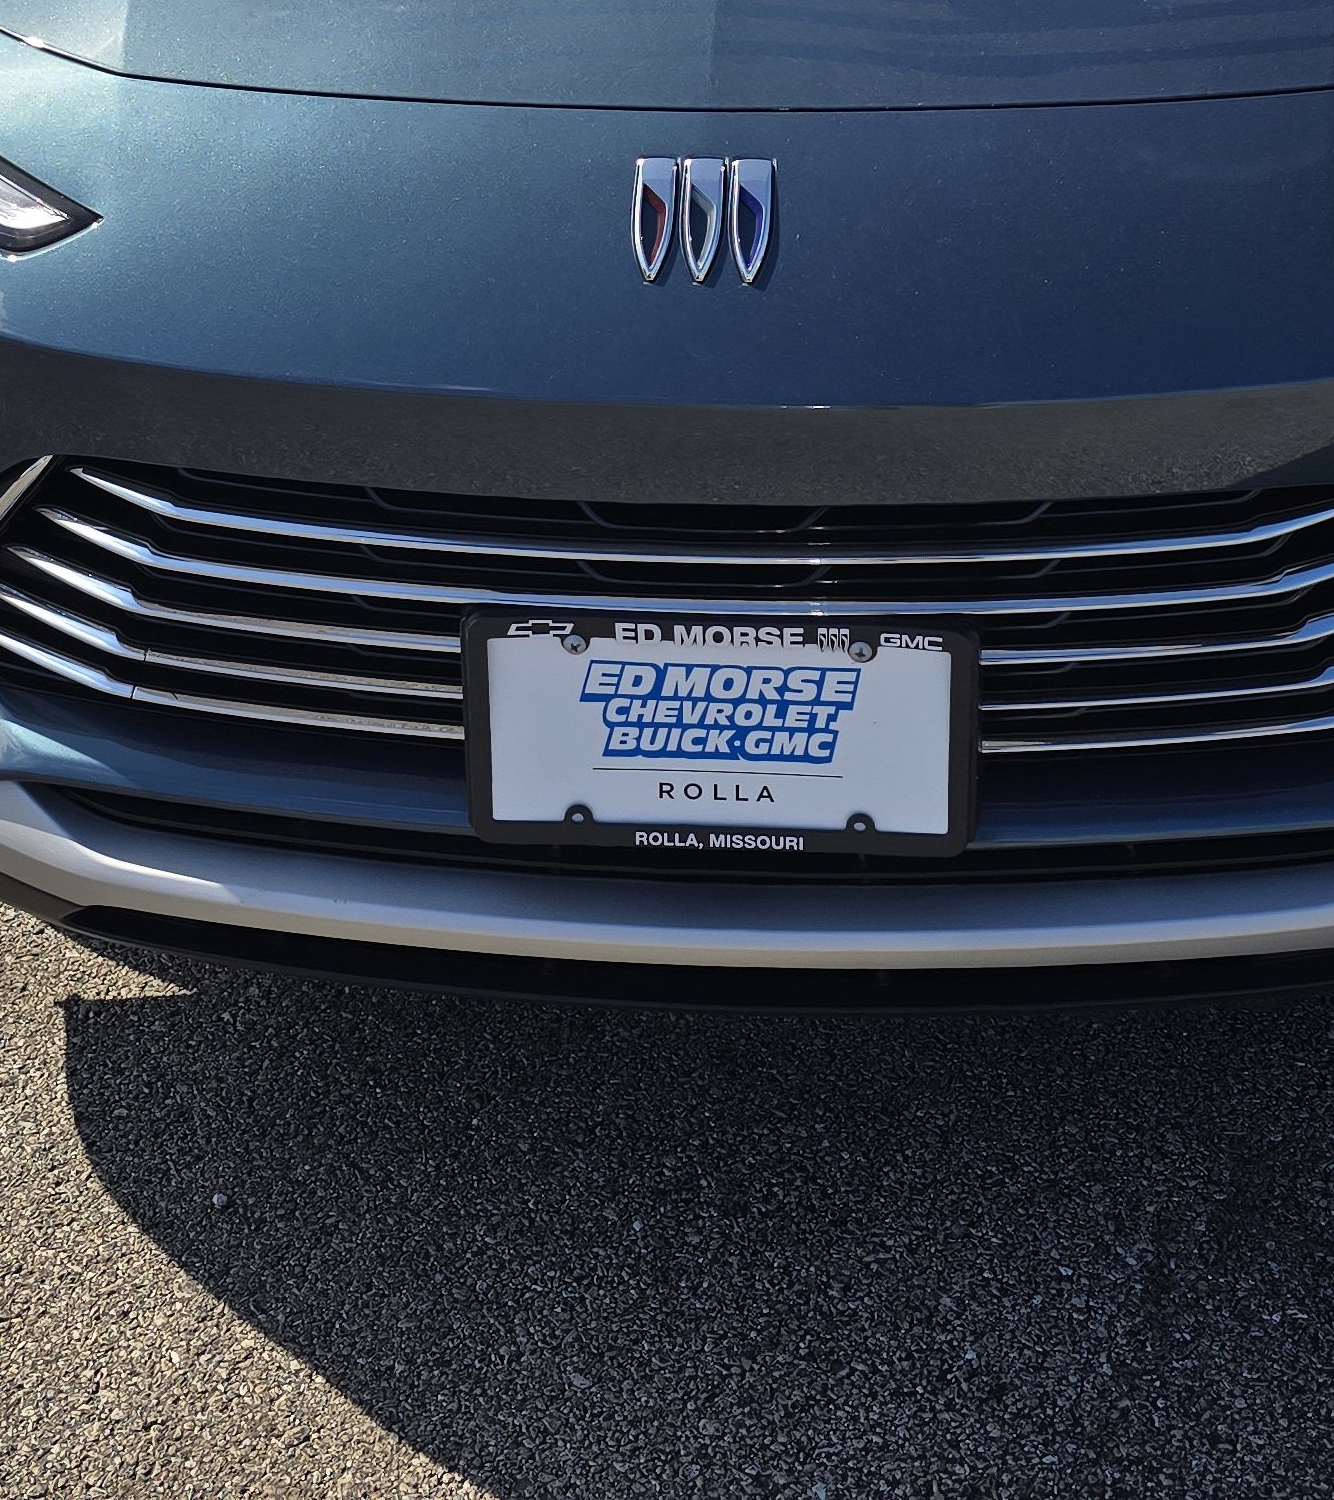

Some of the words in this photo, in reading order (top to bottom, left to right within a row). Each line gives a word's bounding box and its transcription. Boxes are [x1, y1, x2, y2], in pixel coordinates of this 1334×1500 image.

[615, 622, 662, 645] ED
[673, 624, 805, 649] MORSE
[879, 633, 944, 651] GMC
[585, 663, 656, 696] ED
[661, 666, 858, 702] MORSE
[605, 698, 836, 729] CHEVROLET
[659, 782, 775, 802] ROLLA
[635, 831, 704, 850] ROLLA,
[709, 833, 804, 851] MISSOURI
